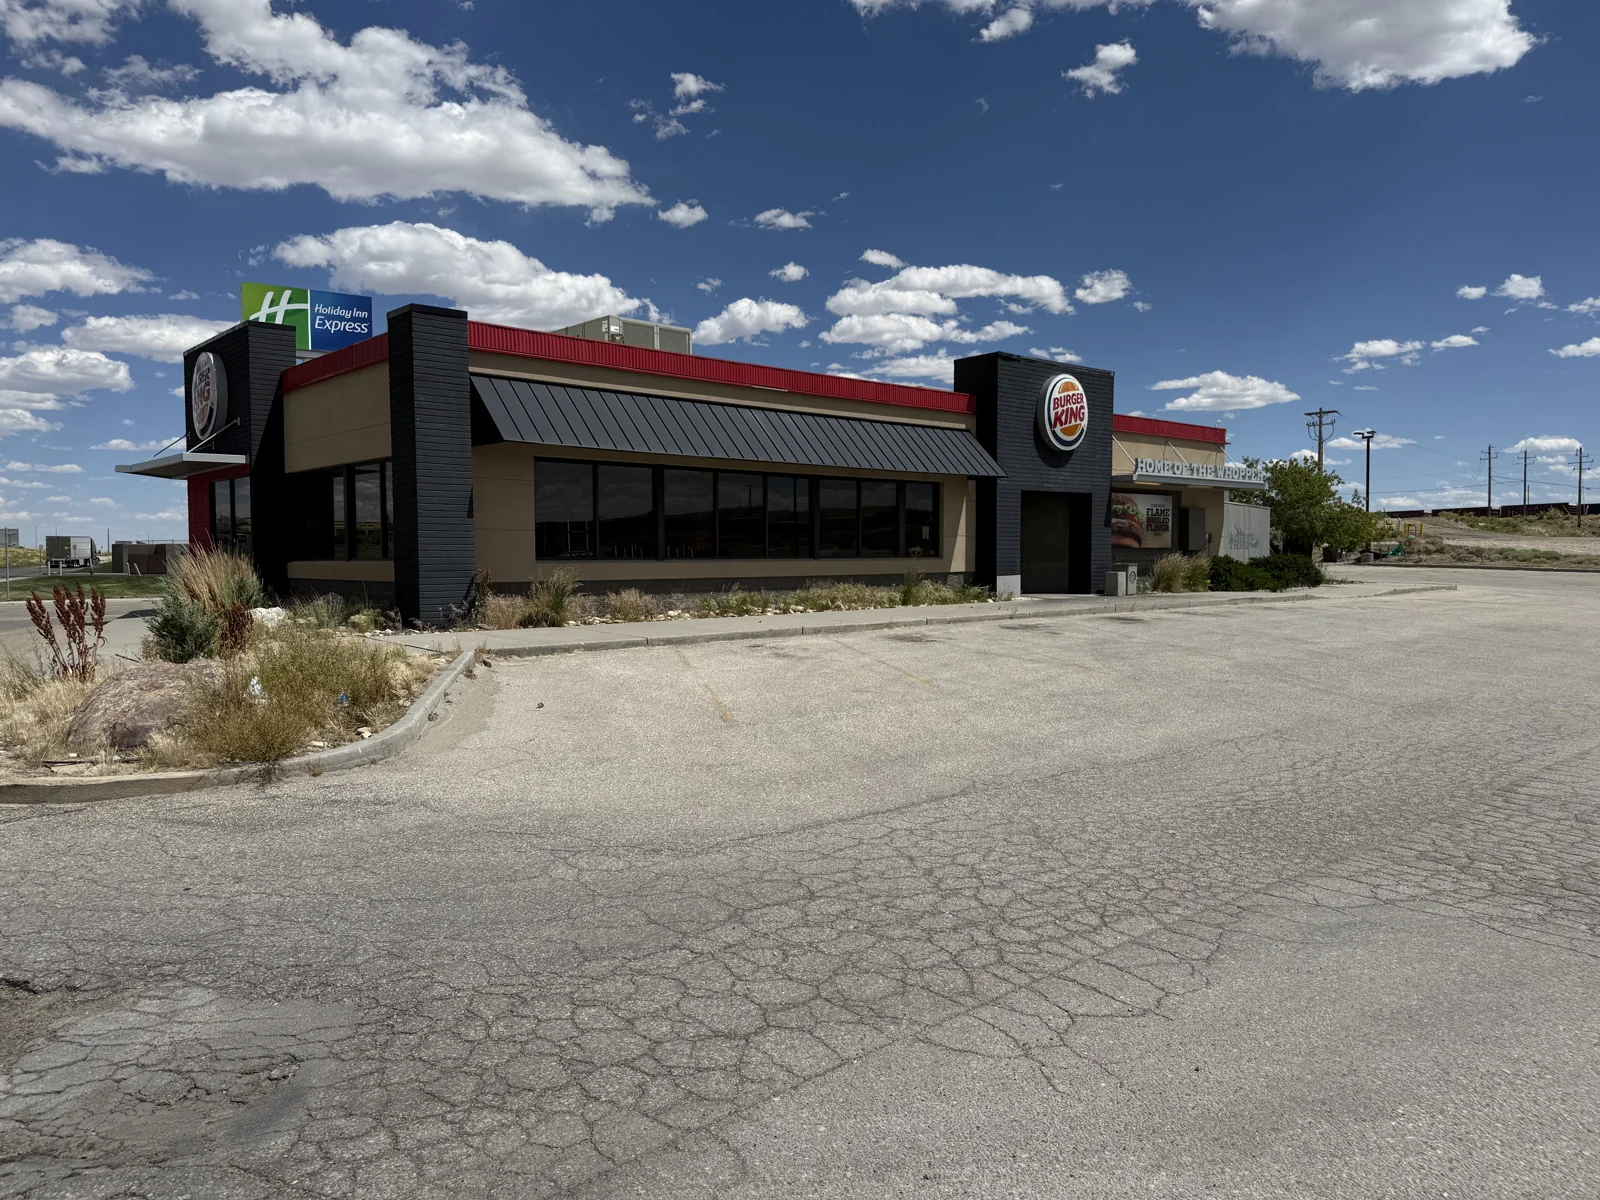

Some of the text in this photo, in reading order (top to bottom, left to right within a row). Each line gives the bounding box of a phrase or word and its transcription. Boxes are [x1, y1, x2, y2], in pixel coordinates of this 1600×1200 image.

[314, 303, 368, 319] Holiday Inn
[314, 315, 369, 333] Express
[1053, 393, 1085, 411] BURGER
[1052, 405, 1085, 429] KING
[1136, 458, 1264, 482] HOME OF THE WHOPPER
[1146, 508, 1170, 517] FLAME
[1146, 524, 1170, 532] FLAVOR
[1229, 540, 1249, 550] THRU
